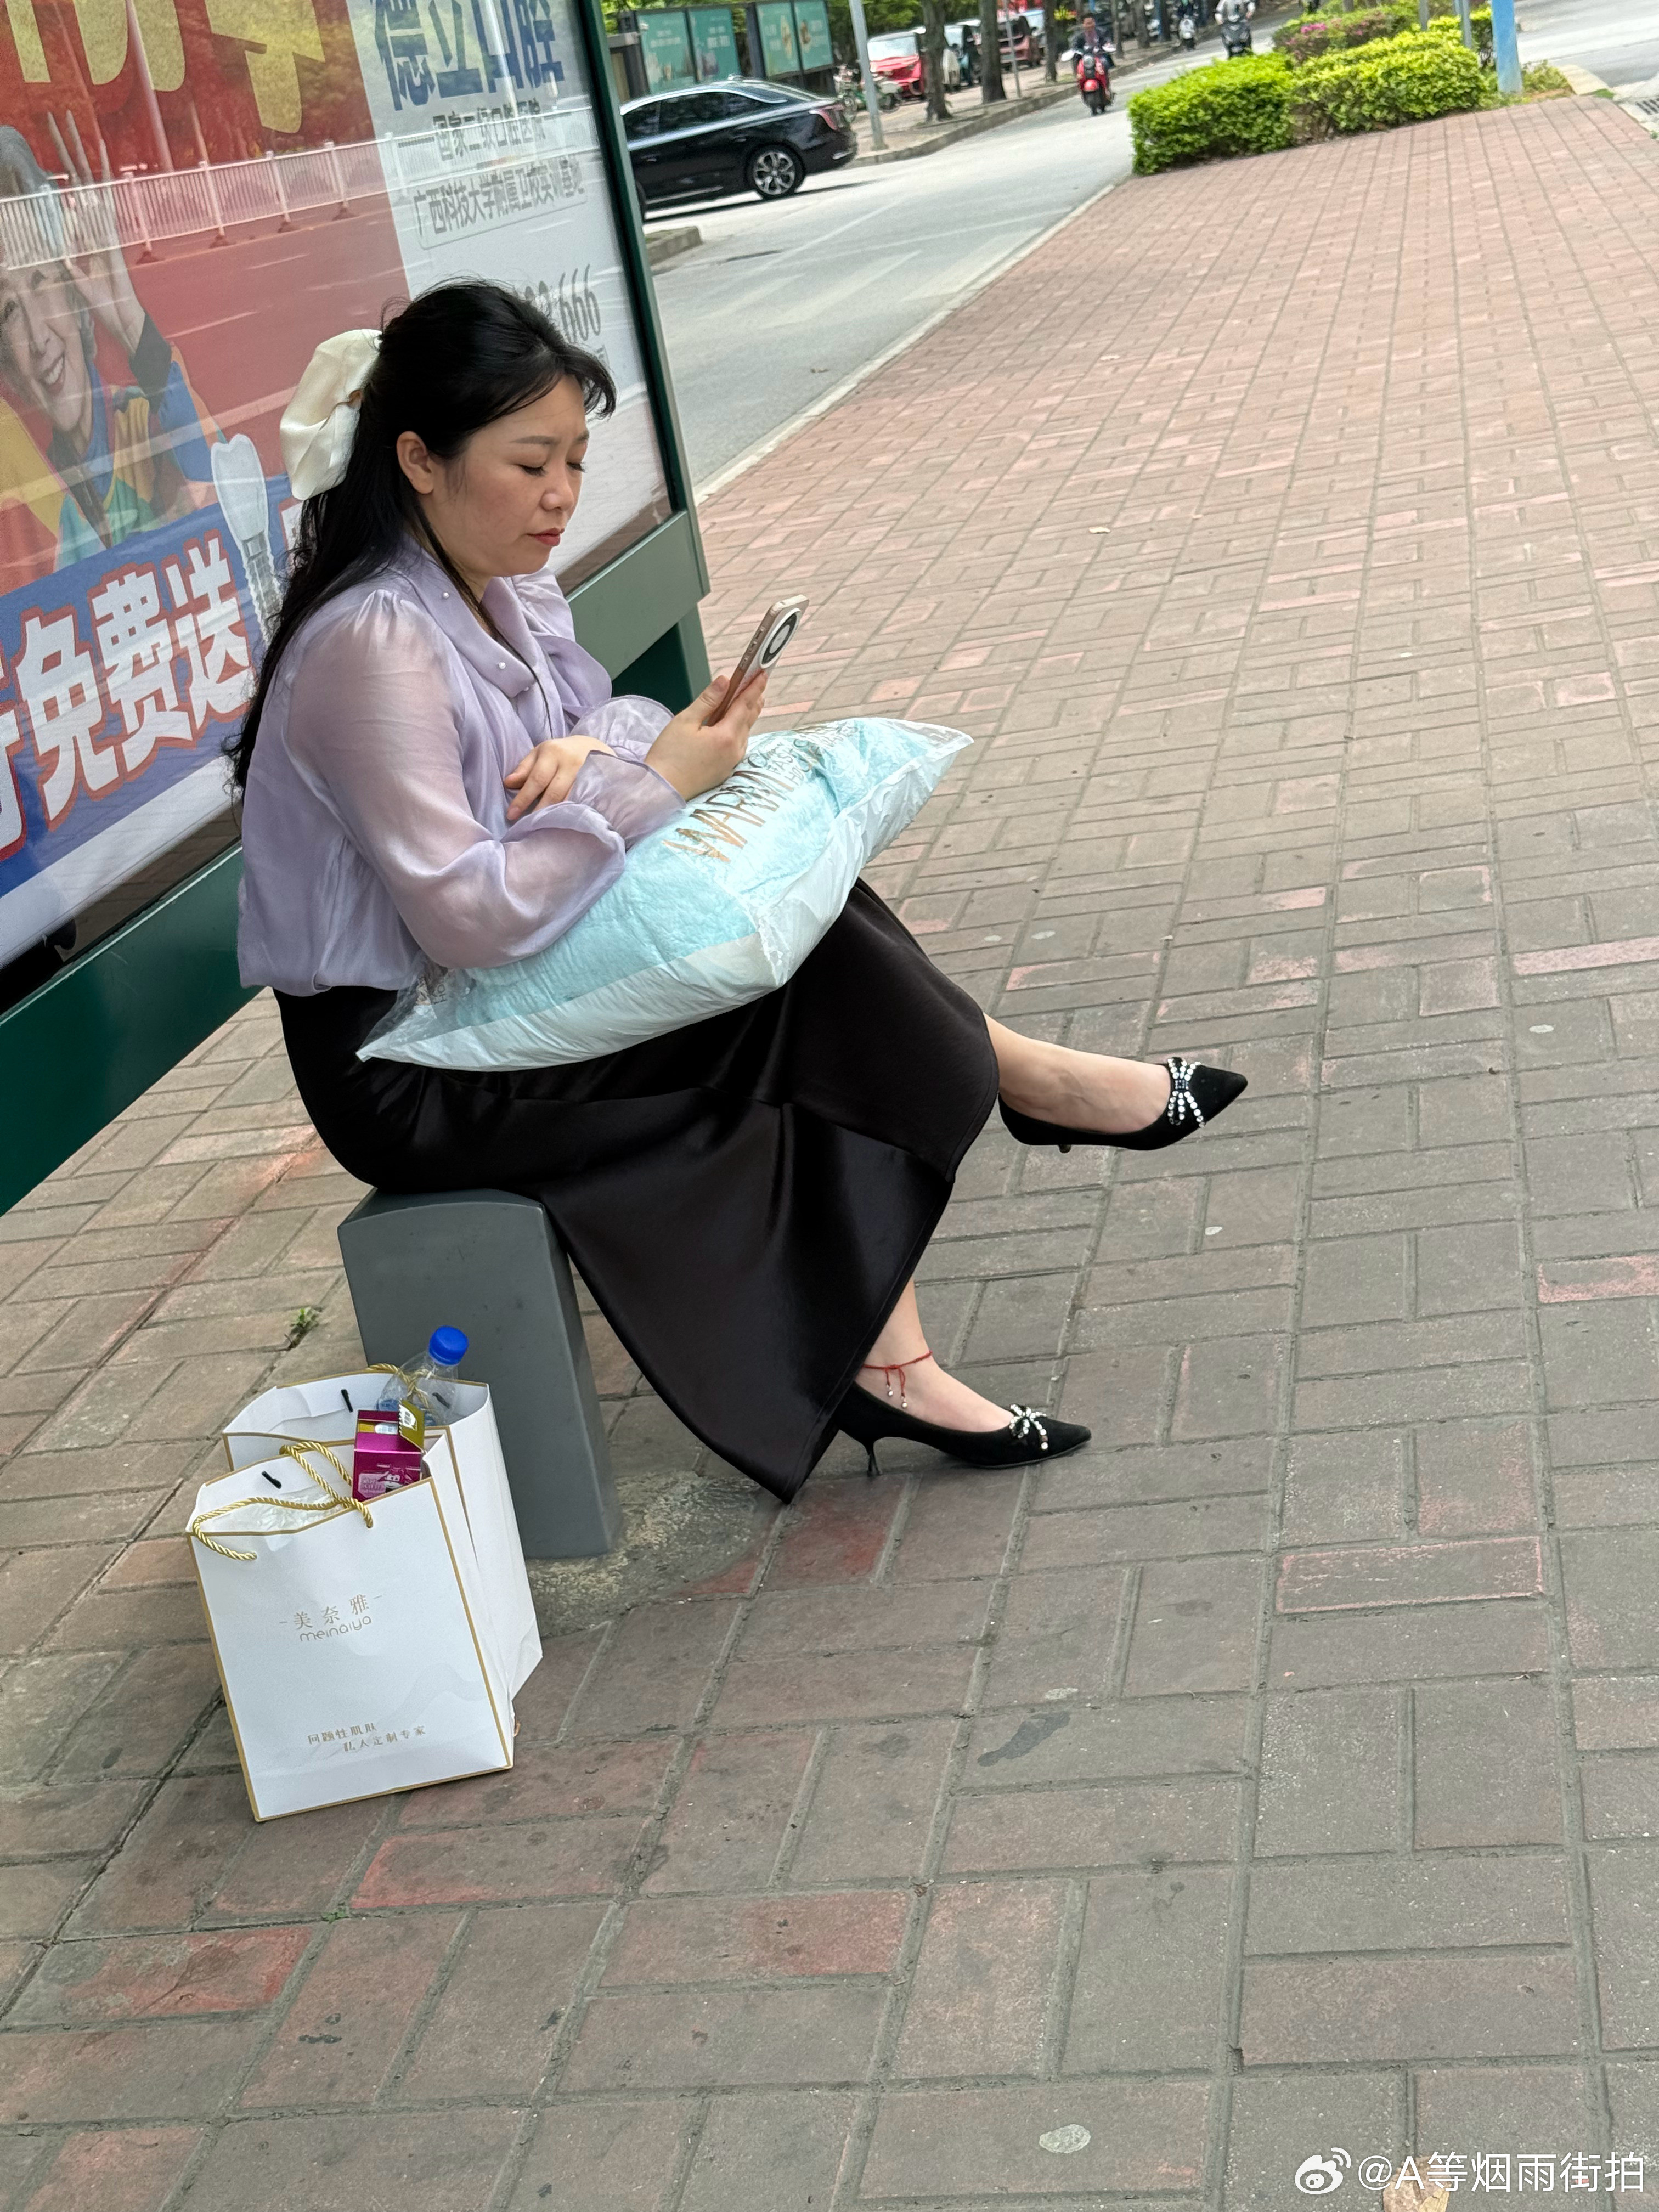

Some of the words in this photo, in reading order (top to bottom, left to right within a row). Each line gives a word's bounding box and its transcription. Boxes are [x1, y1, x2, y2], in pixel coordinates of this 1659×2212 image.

[370, 0, 565, 111] 德立口腔
[433, 98, 546, 162] 国家二级口腔医院
[0, 538, 256, 848] 免费送
[294, 1594, 369, 1630] 美奈雅
[299, 1616, 372, 1642] meinaiya
